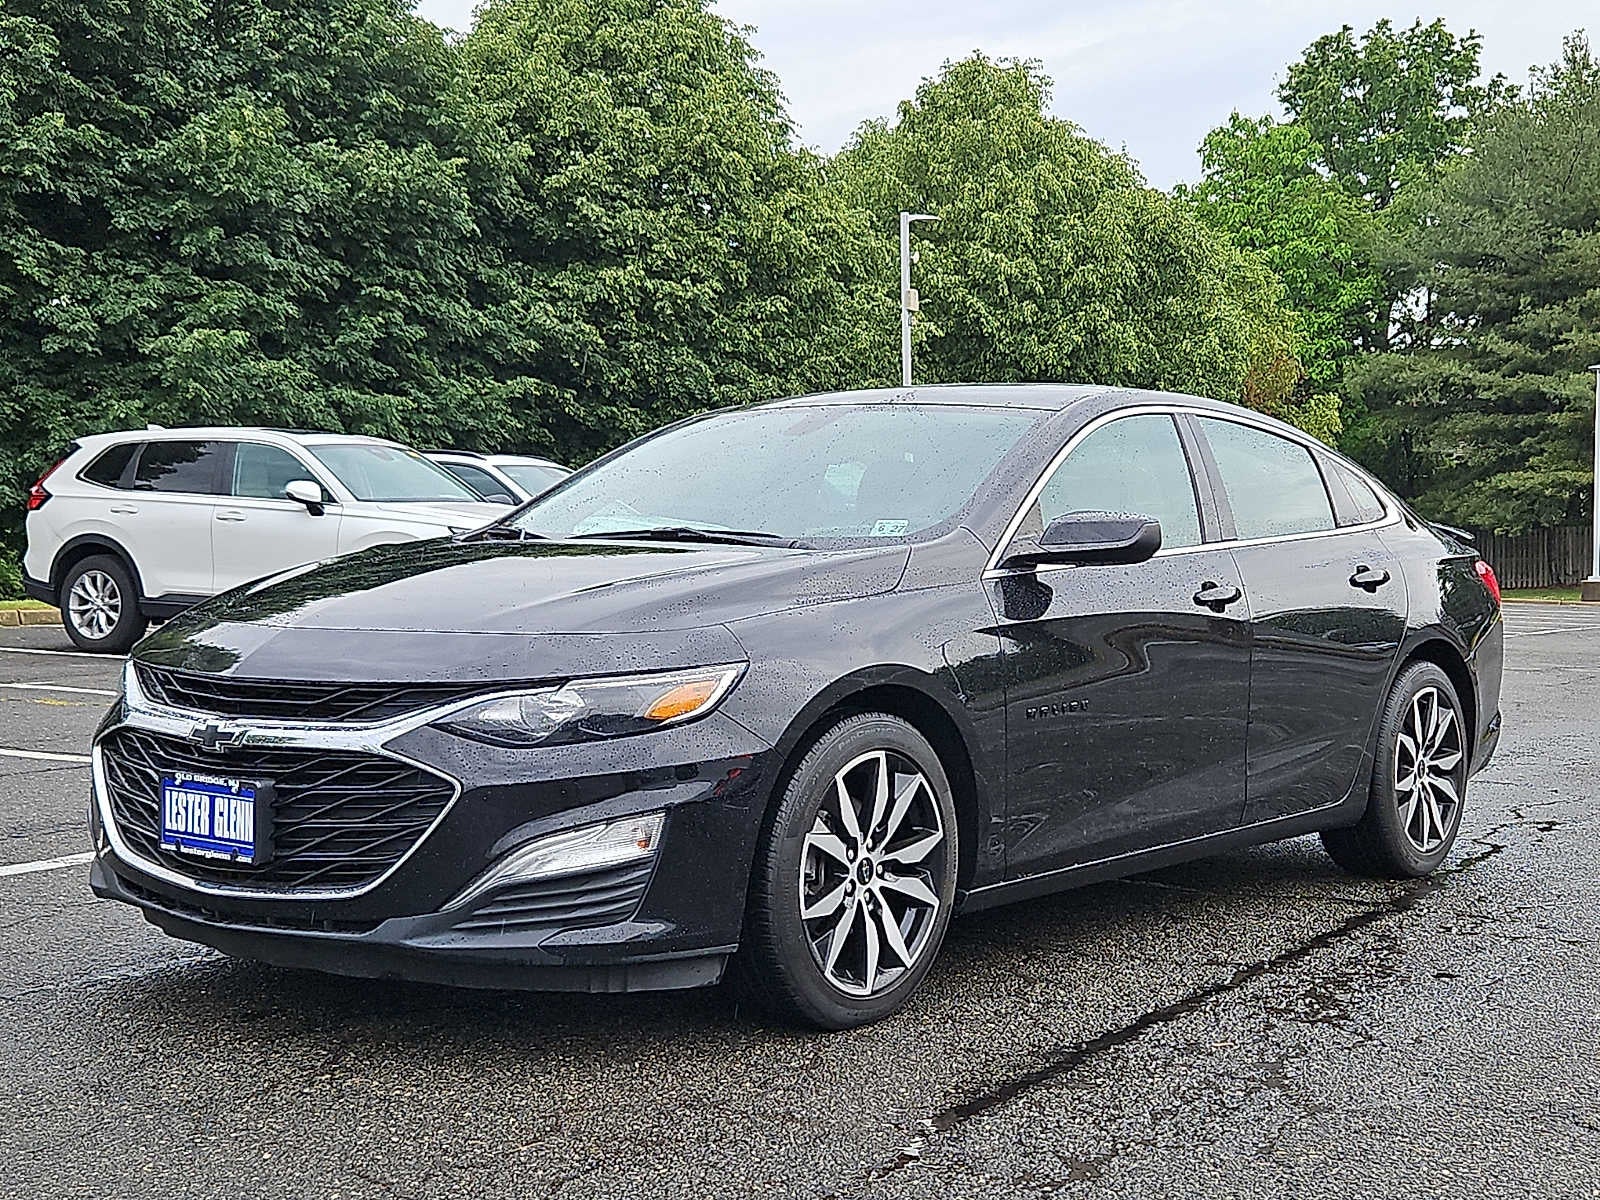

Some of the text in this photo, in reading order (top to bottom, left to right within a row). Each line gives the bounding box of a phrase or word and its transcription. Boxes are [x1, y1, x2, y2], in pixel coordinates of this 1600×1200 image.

[174, 772, 193, 781] OLD
[165, 790, 254, 842] LESTER GLENN
